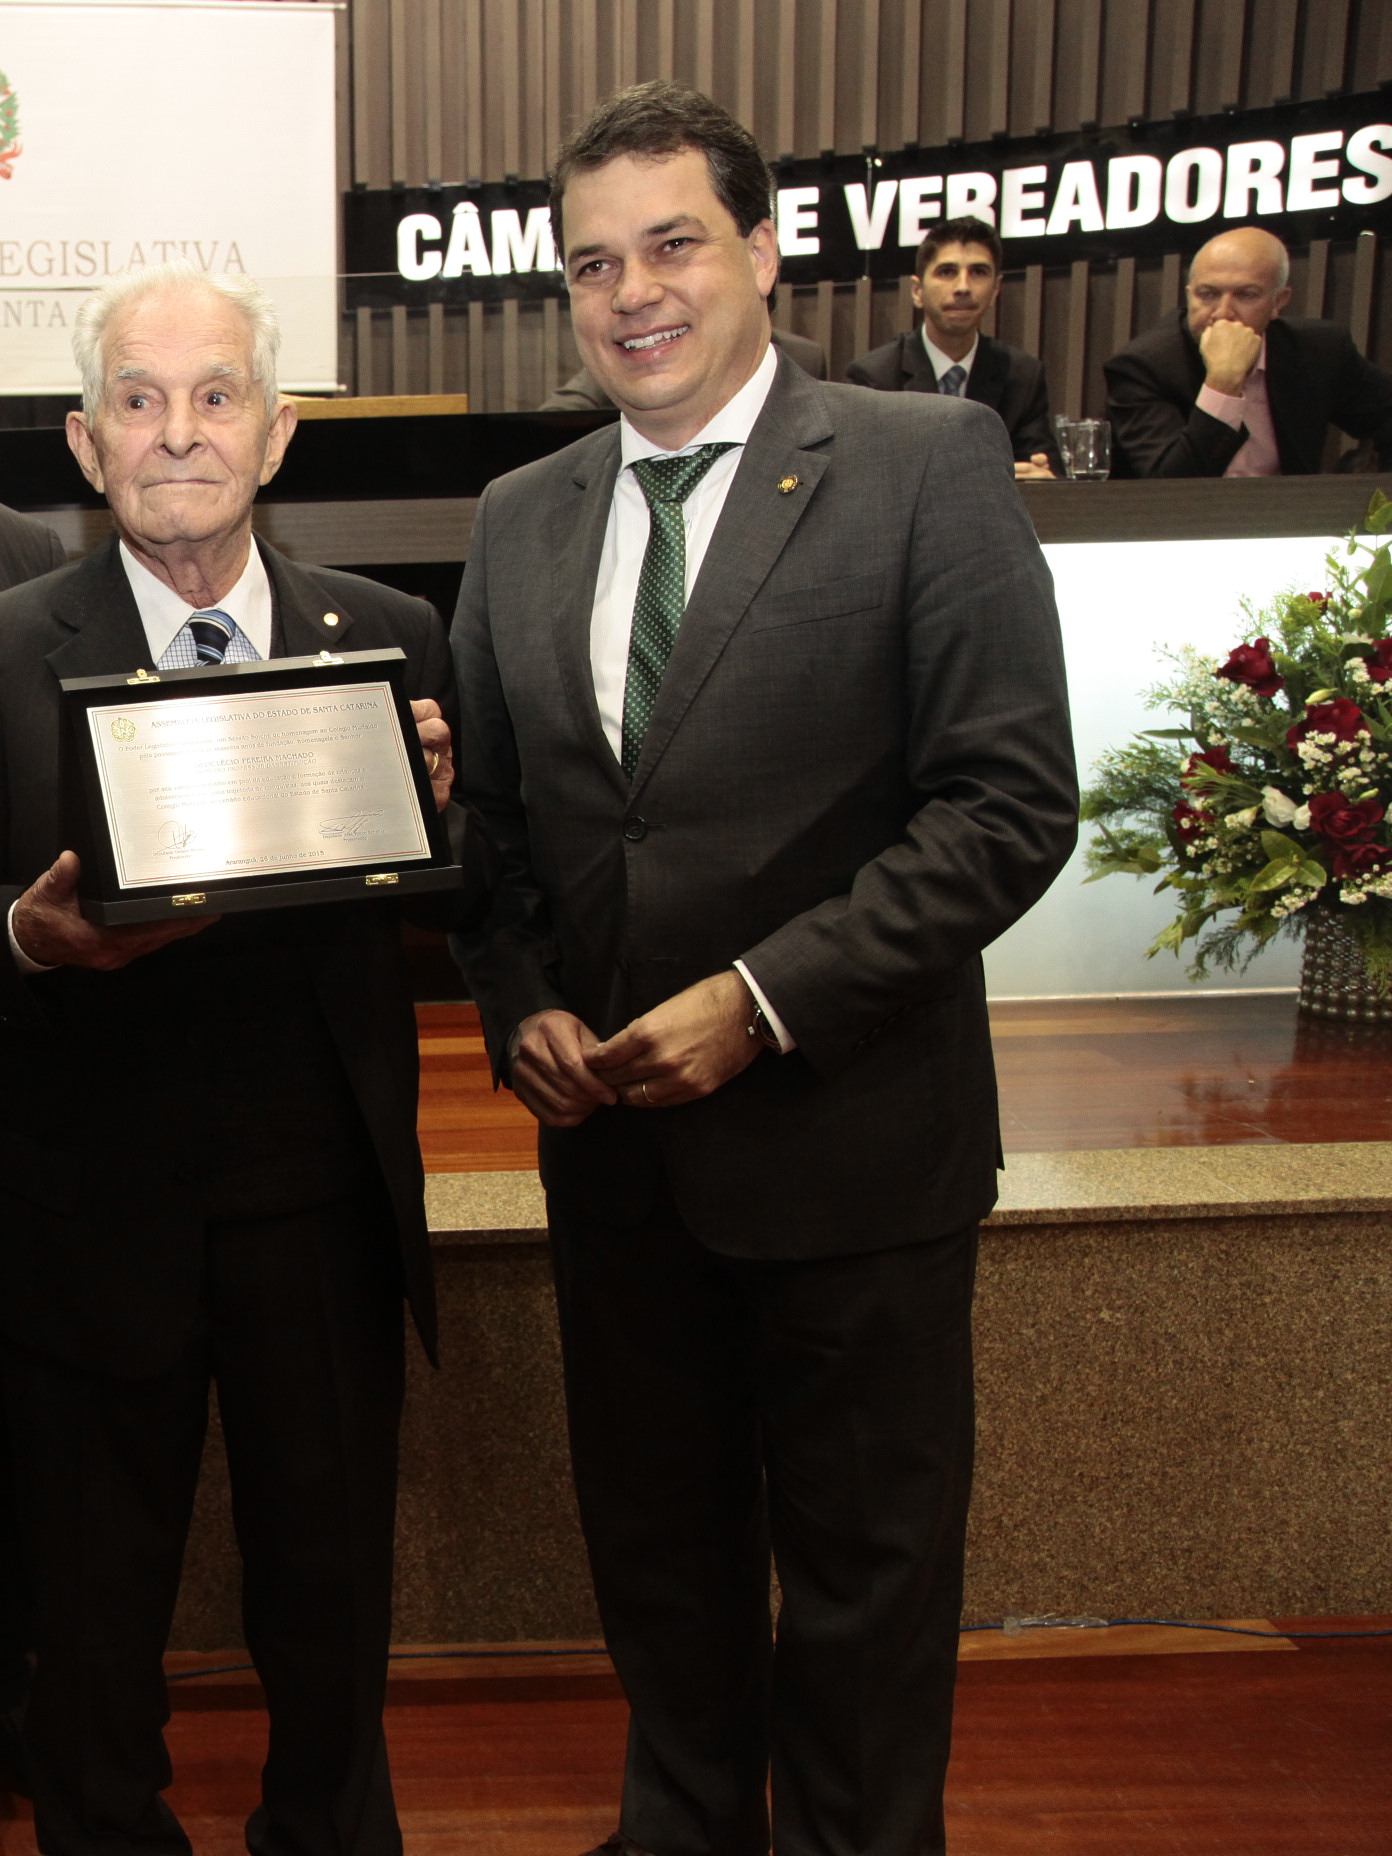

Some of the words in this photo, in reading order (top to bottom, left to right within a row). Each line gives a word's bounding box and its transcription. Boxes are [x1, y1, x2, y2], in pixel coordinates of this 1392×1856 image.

[396, 202, 564, 281] CÂM
[776, 186, 820, 257] E
[843, 123, 1392, 251] VEREADORES
[267, 709, 299, 718] ESTADO
[300, 707, 312, 715] DE
[313, 705, 339, 714] SANTA
[340, 701, 378, 711] CATARINA
[275, 751, 314, 761] MACHADO
